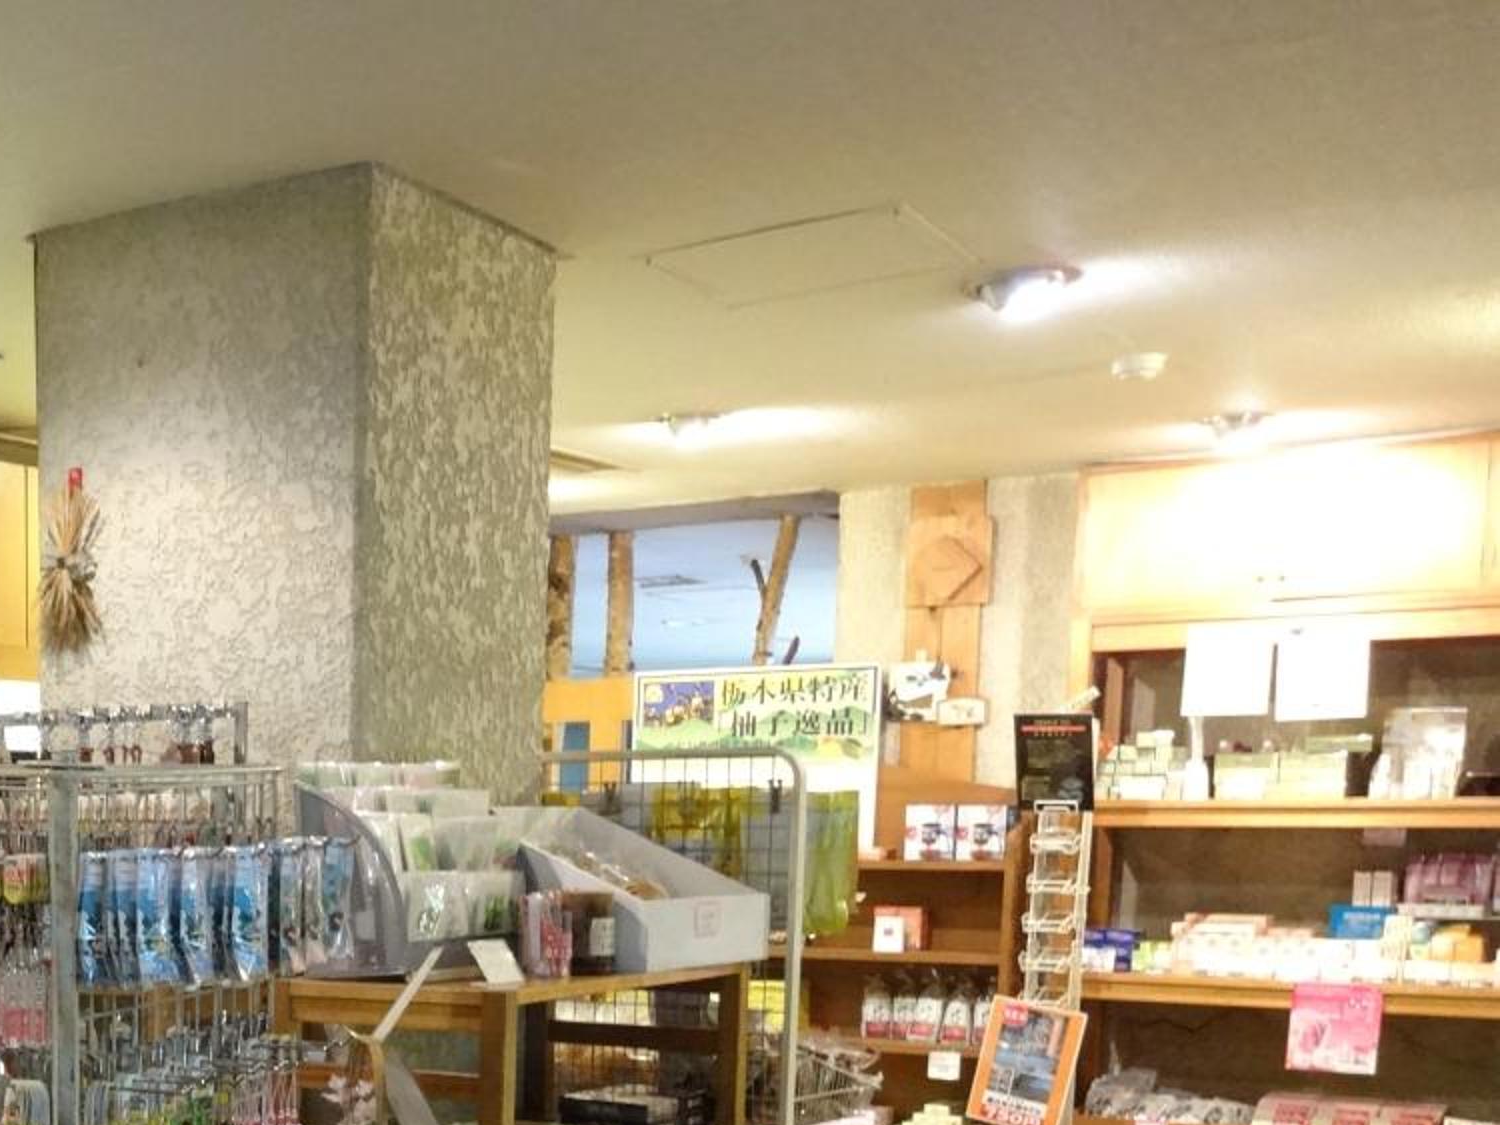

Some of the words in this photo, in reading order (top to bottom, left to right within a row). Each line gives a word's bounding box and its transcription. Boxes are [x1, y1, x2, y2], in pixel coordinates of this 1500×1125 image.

[722, 673, 869, 706] 栃木県特産
